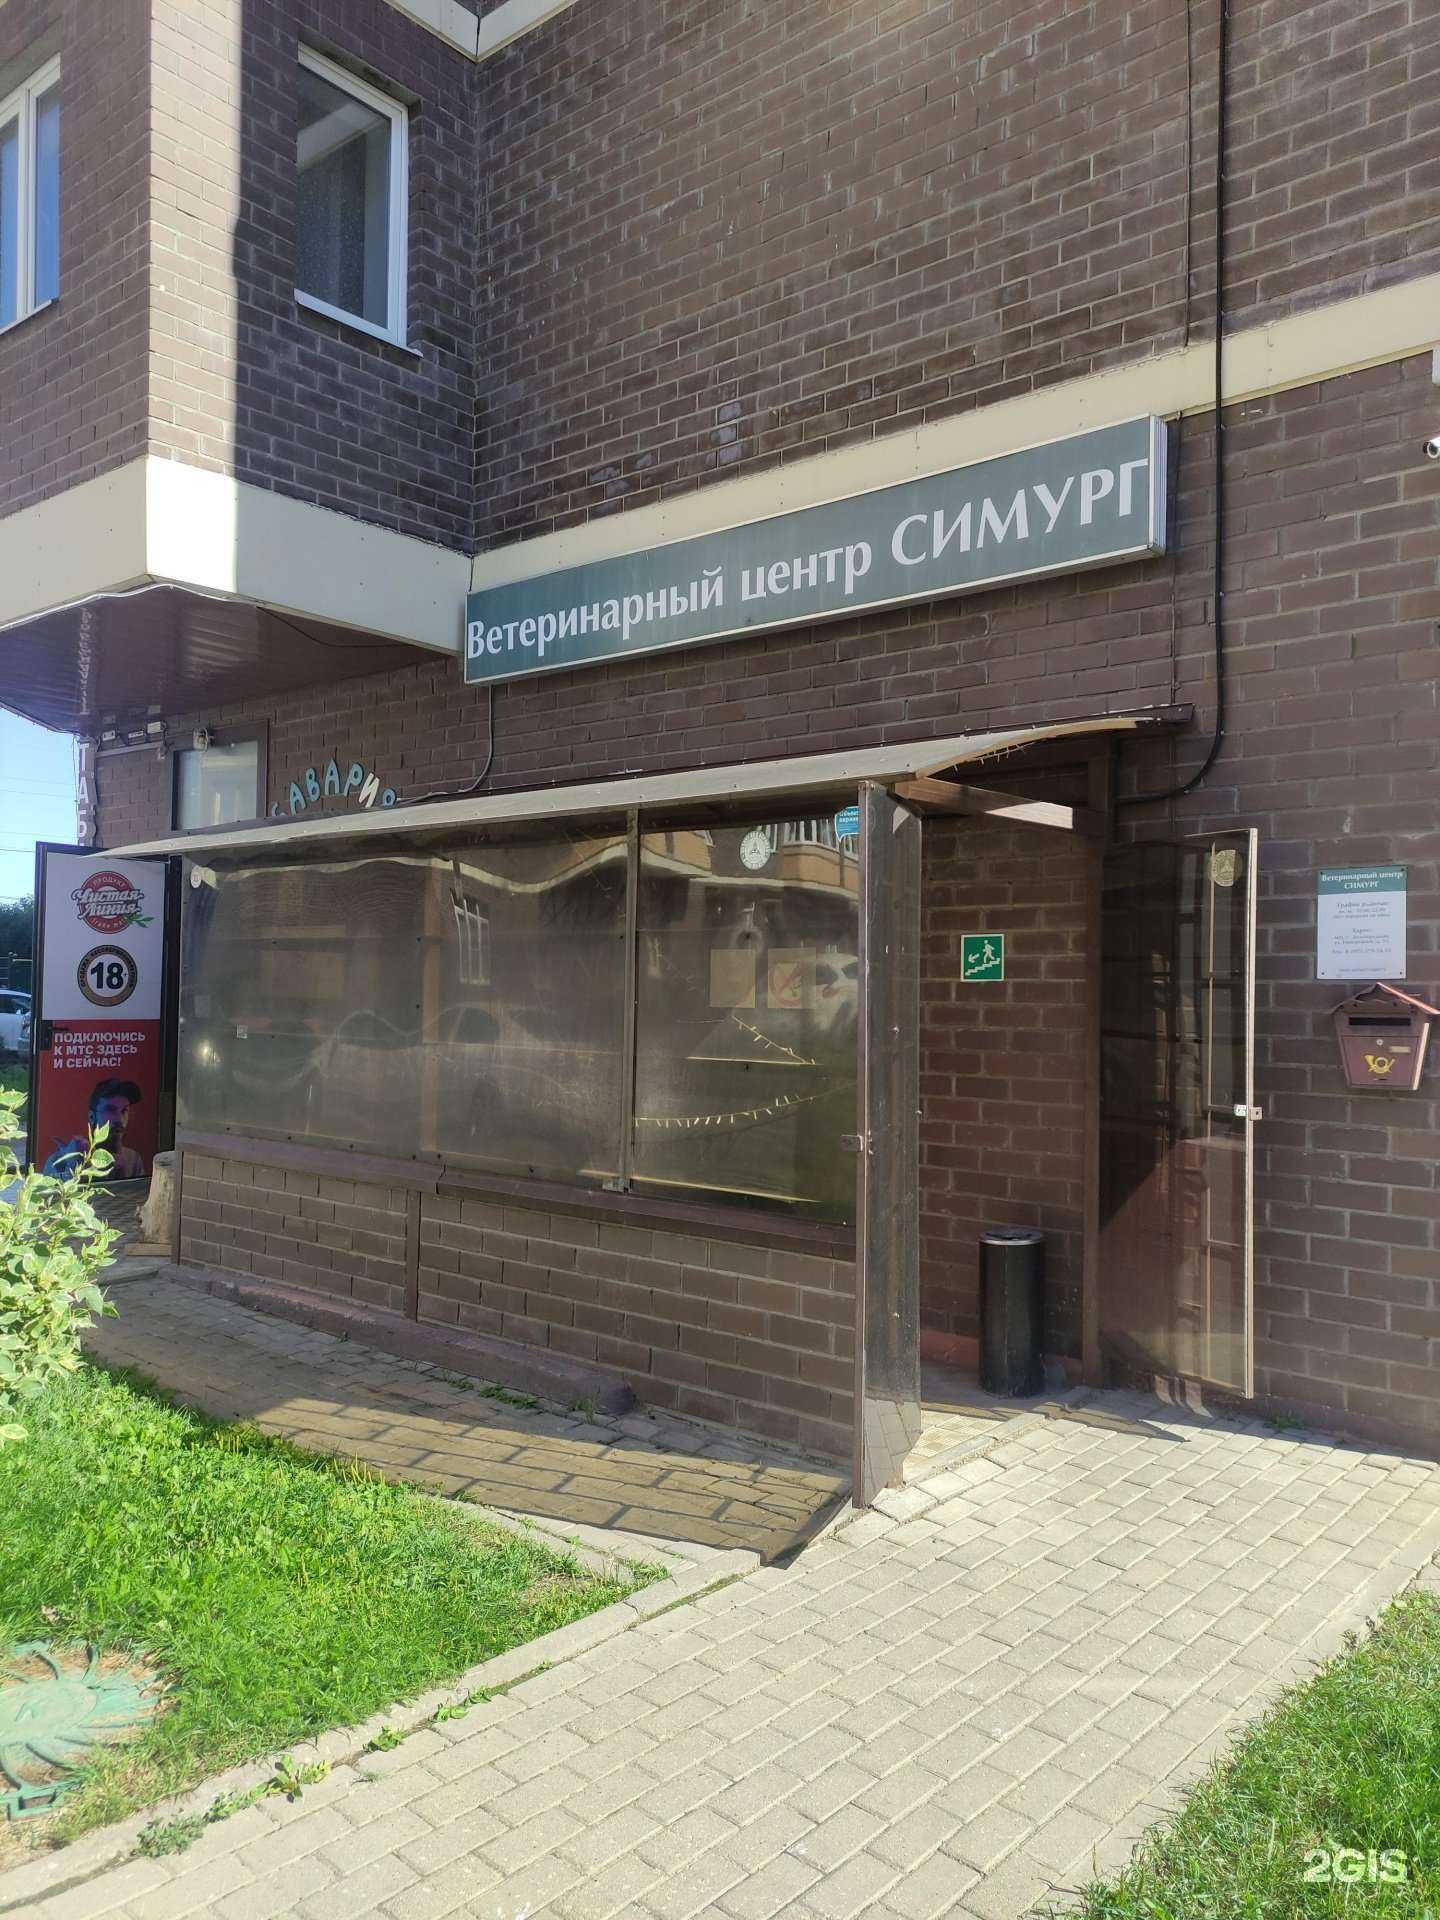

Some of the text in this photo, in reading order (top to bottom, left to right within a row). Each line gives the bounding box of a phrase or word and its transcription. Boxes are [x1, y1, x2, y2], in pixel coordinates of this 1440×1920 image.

[468, 458, 1149, 657] Ветеринарный центр СИМУРГ
[1322, 871, 1403, 882] Ветеринарный центр
[1344, 881, 1379, 890] СИМУРГ
[72, 888, 144, 903] Чистая
[78, 902, 141, 920] Линия
[54, 1031, 146, 1043] ПОДКЛЮЧИСЬ
[54, 1044, 138, 1056] К МТС ЗДЕСЬ
[53, 1055, 121, 1068] И СЕЙЧАС!
